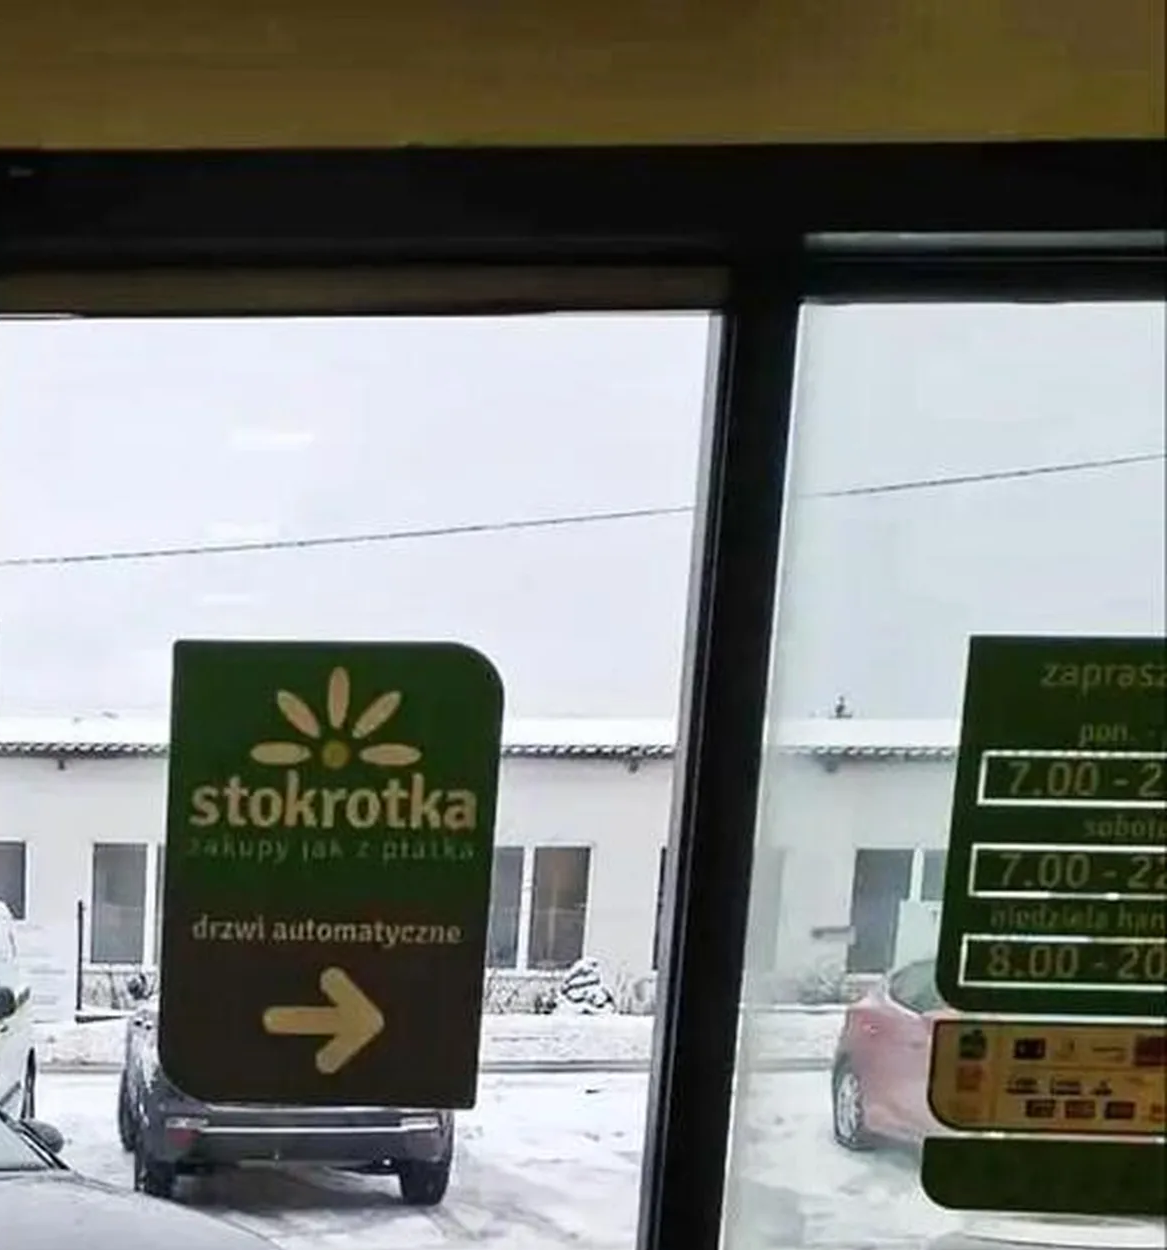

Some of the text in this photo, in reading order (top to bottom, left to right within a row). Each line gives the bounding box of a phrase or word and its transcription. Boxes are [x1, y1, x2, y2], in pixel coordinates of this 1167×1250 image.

[1006, 761, 1100, 797] 7.00
[189, 770, 477, 831] stokrotka
[186, 835, 290, 864] zakupy
[300, 836, 344, 863] jak
[998, 853, 1092, 889] 7.00
[191, 914, 463, 949] drzwi automatyczne
[986, 944, 1080, 979] 8.00
[1117, 946, 1167, 981] 20
